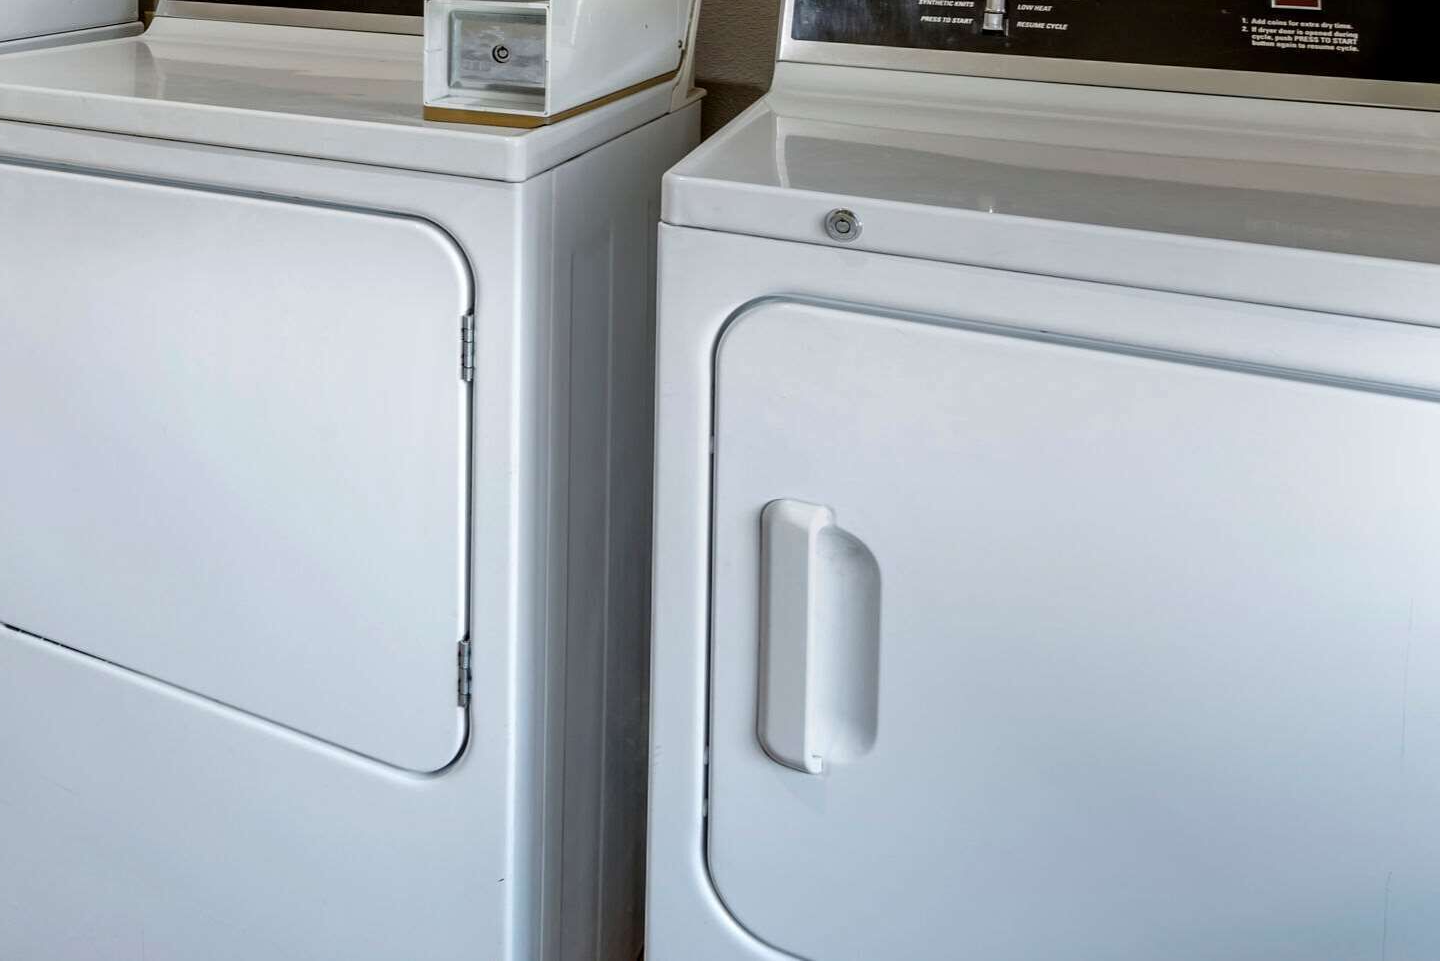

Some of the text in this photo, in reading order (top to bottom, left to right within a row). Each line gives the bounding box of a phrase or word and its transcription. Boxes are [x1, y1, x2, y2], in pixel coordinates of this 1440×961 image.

[1016, 21, 1045, 29] RESUME
[1294, 35, 1319, 43] PRESS
[1332, 37, 1357, 45] START
